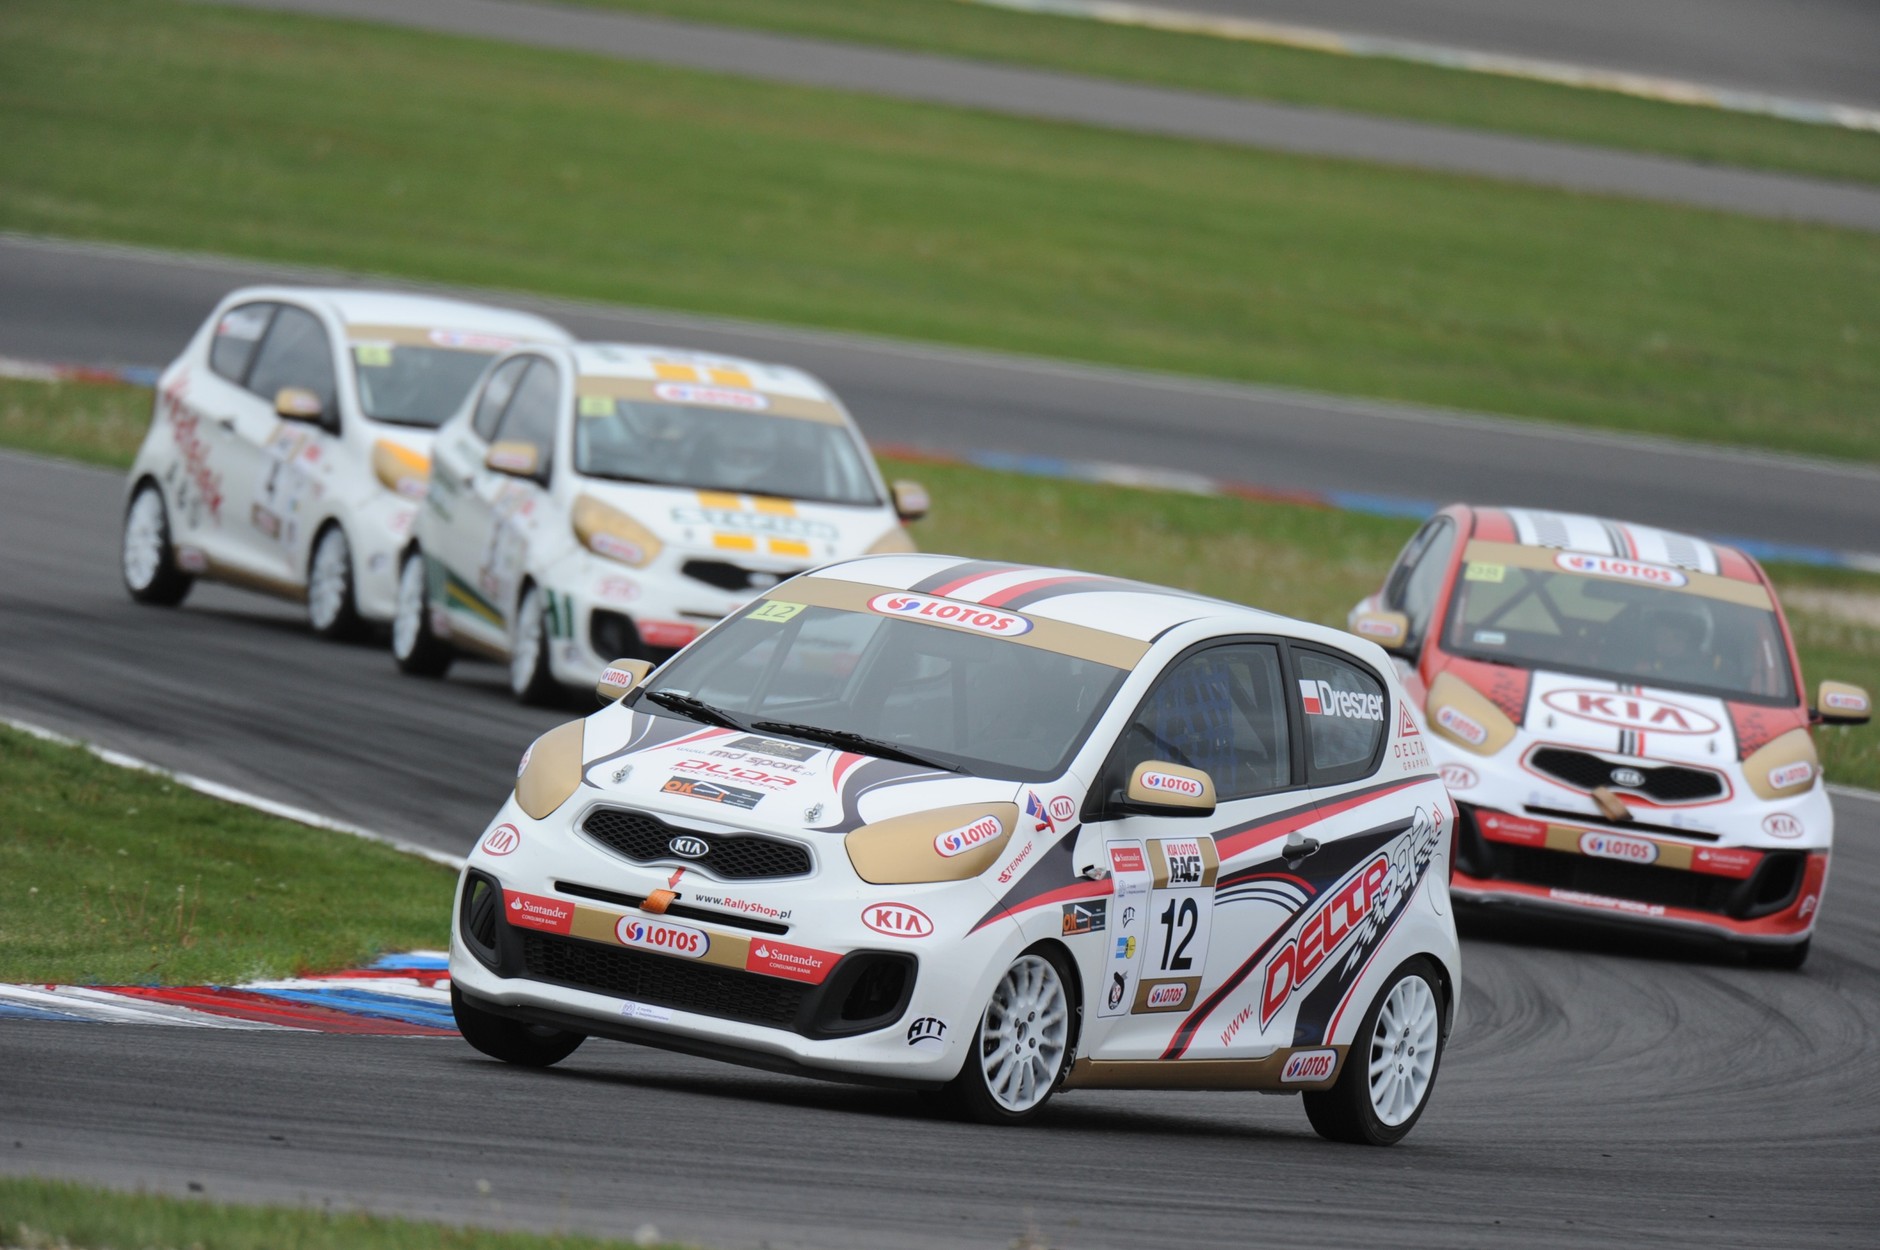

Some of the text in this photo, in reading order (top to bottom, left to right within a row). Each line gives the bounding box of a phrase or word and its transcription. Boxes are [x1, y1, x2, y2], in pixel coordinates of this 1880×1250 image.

[1599, 559, 1673, 583] LOTOS
[756, 604, 796, 618] 12
[919, 602, 1016, 631] LOTOS
[607, 670, 629, 685] LOTOS
[1318, 680, 1384, 721] Dreszer
[1576, 693, 1692, 730] KIA
[1394, 741, 1427, 758] DELTA
[673, 759, 798, 787] DUDA
[1614, 770, 1640, 784] KIA
[664, 780, 696, 794] OK
[1161, 776, 1197, 793] LOTOS
[1054, 804, 1073, 817] KIA
[960, 819, 998, 846] LOTOS
[1770, 820, 1798, 834] KIA
[486, 829, 514, 852] KIA
[674, 839, 701, 855] KIA
[1167, 842, 1199, 856] KIA LOTOS
[1605, 840, 1649, 859] LOTOS
[998, 841, 1034, 883] STEINHOF
[1169, 856, 1200, 883] RACE
[523, 901, 568, 920] Santander
[695, 893, 792, 919] www.RallyShop.pl
[876, 909, 923, 934] KIA
[646, 925, 699, 952] LOTOS
[1160, 897, 1198, 971] 12
[769, 962, 811, 975] CONSUMER BANK
[770, 948, 823, 969] Santander
[1159, 987, 1184, 1003] LOTOS
[907, 1017, 947, 1040] ATT
[1296, 1056, 1332, 1077] LOTOS
